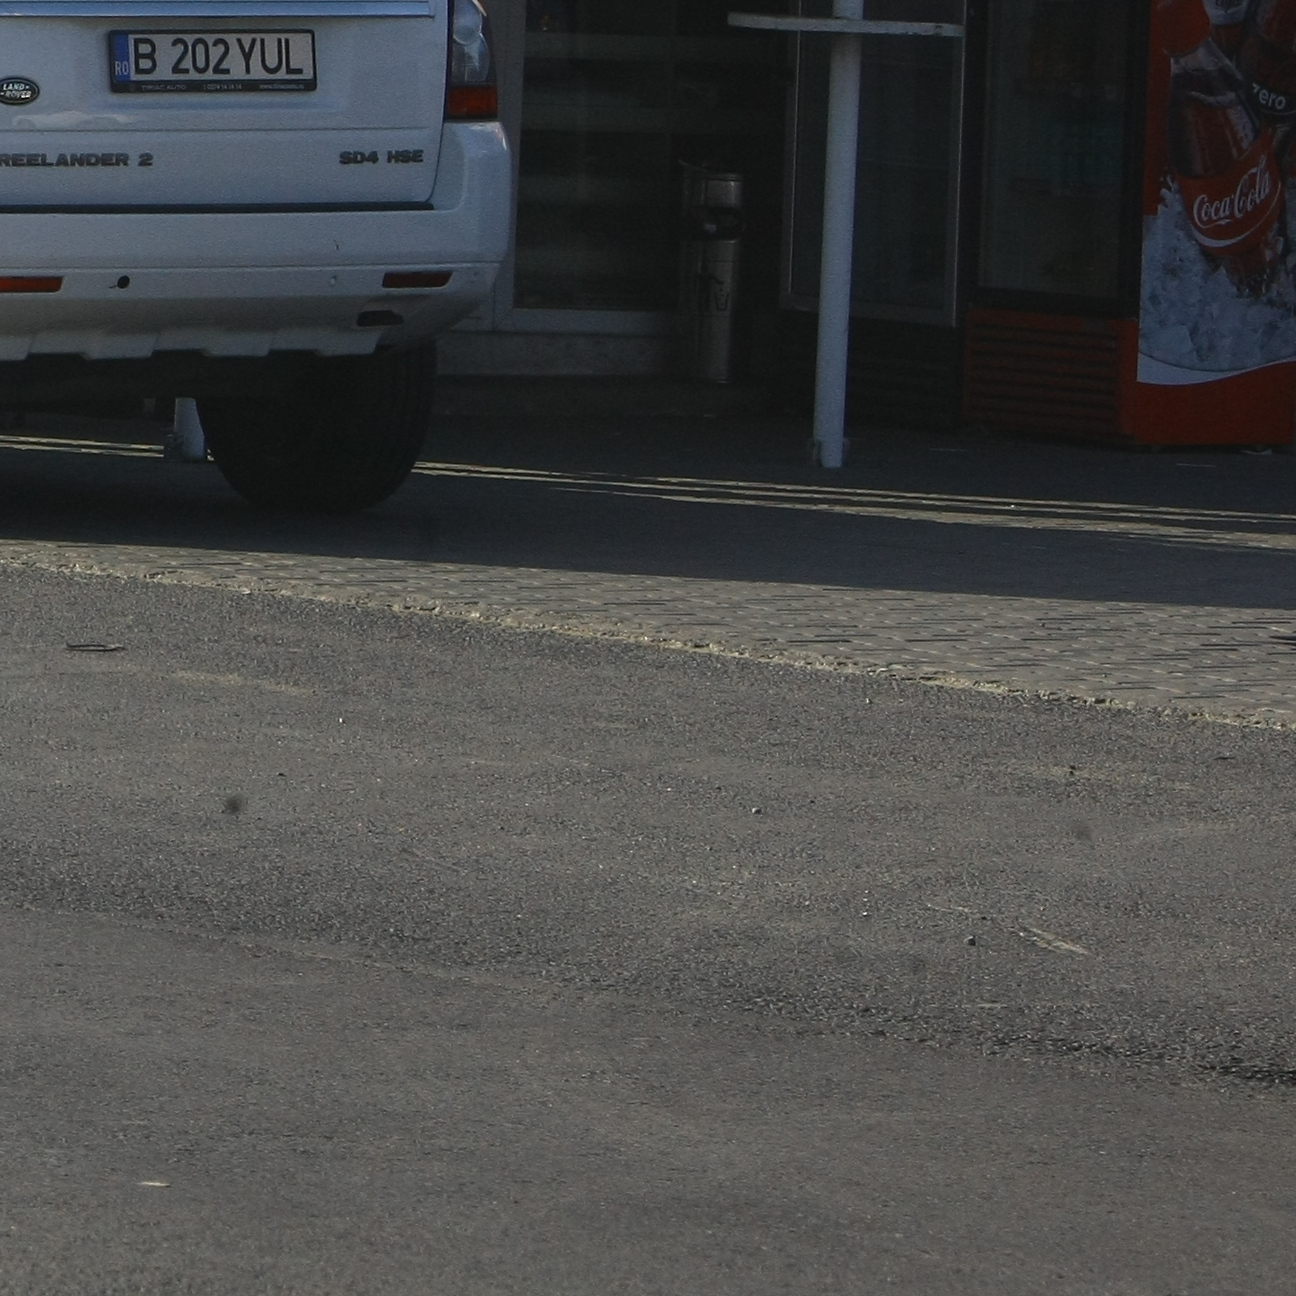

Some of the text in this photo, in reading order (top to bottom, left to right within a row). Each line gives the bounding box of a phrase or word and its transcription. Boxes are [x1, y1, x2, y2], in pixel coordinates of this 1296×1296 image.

[133, 37, 305, 75] B 202 YUL
[114, 60, 129, 76] RO
[138, 152, 154, 167] 2
[338, 150, 424, 165] SD4 HSE
